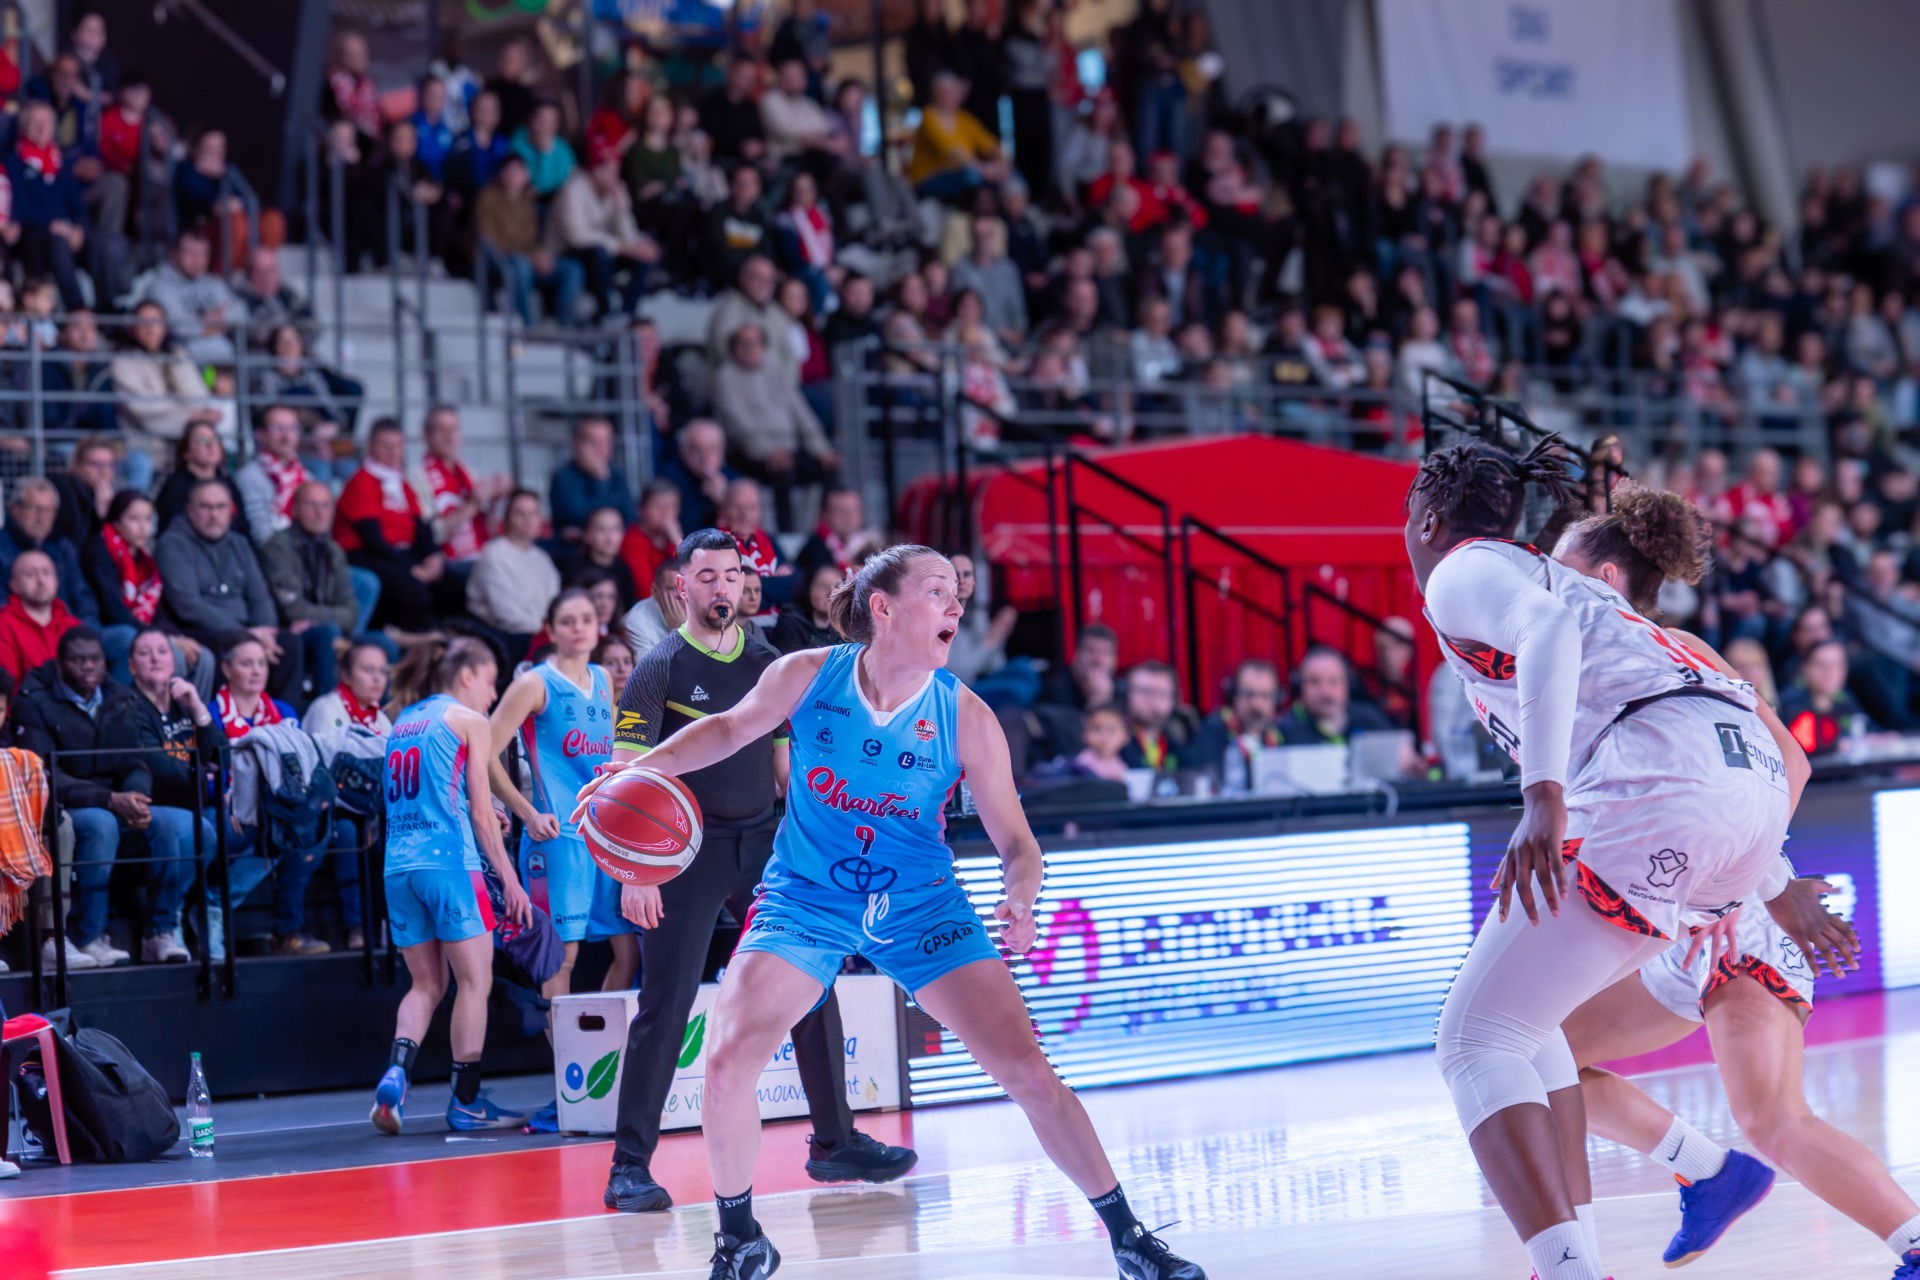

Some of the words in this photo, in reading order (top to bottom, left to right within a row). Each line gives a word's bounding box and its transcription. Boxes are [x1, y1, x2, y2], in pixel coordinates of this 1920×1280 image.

[691, 693, 710, 702] PEAK
[814, 700, 851, 718] SPALDING
[621, 731, 647, 742] POSTE
[387, 746, 421, 804] 30
[806, 766, 920, 821] Chartres
[855, 825, 876, 856] 9
